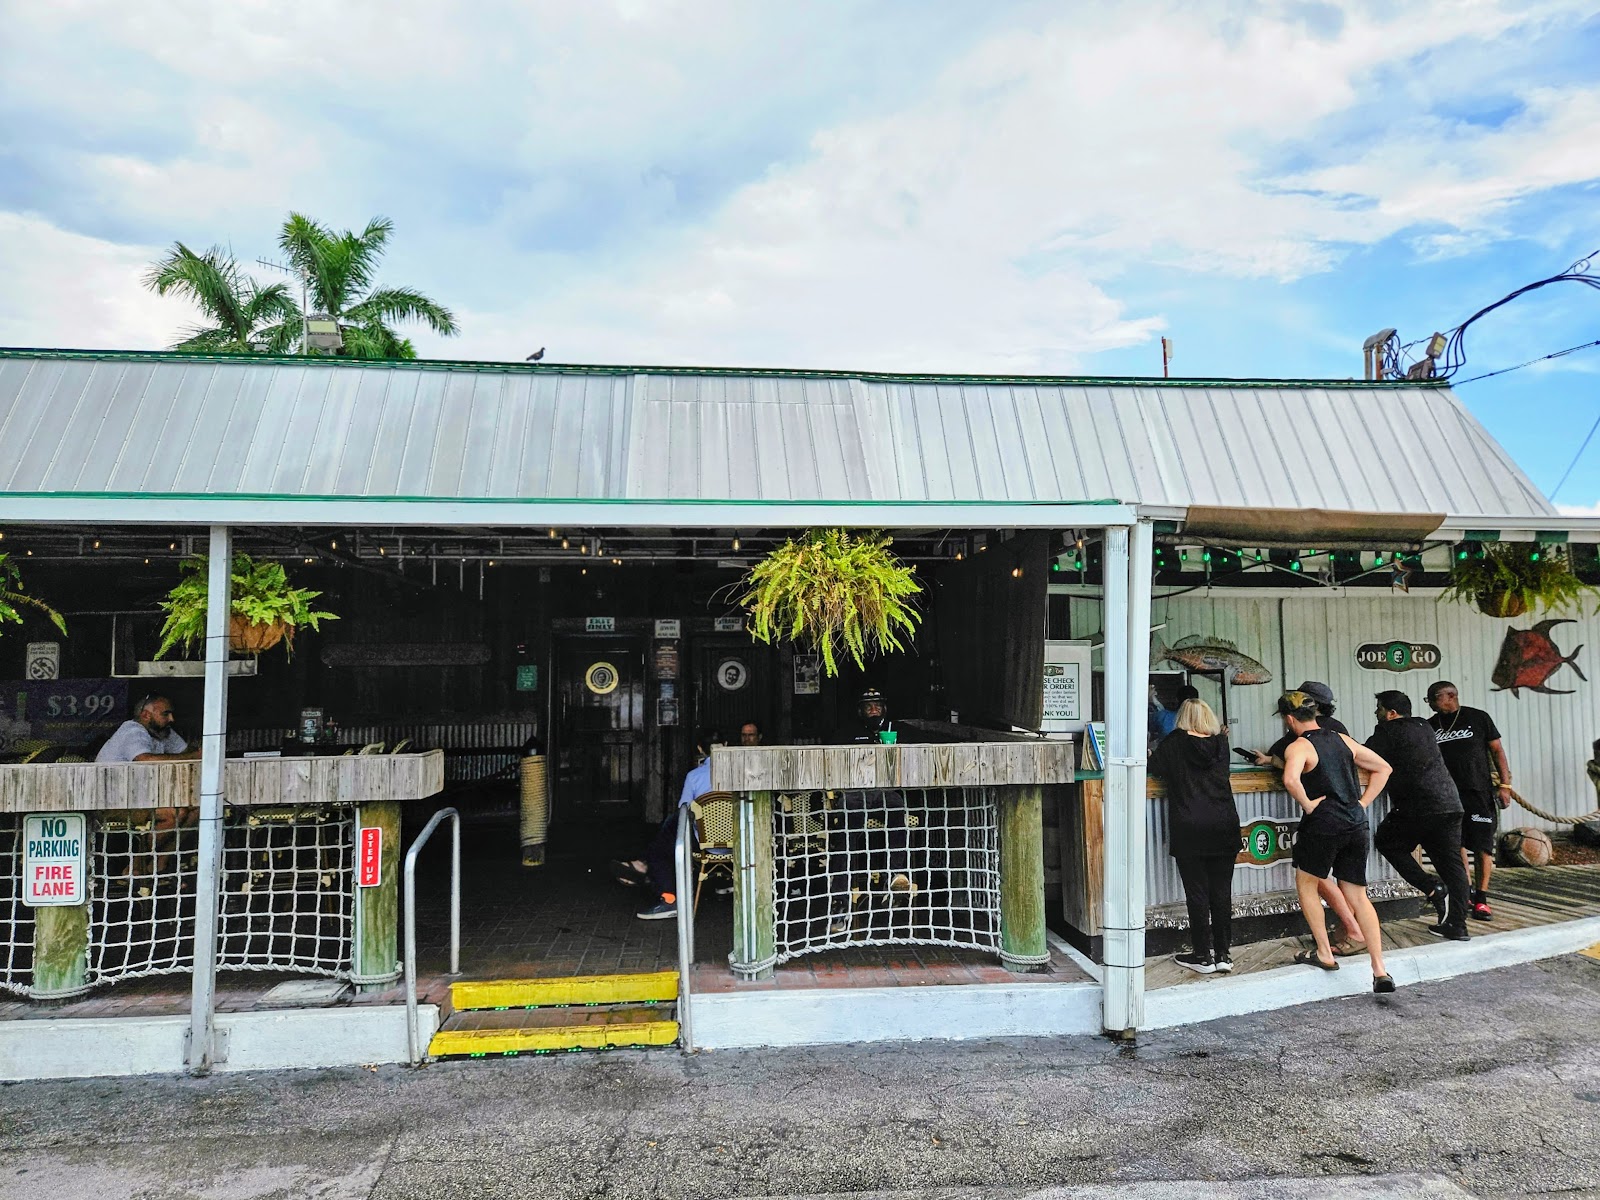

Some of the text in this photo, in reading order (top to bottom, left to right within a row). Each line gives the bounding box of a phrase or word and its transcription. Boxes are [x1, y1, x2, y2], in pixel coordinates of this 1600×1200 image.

[1358, 651, 1387, 662] JOE
[1412, 650, 1436, 663] GO
[47, 694, 115, 717] $3.99
[41, 818, 67, 837] NO
[29, 839, 79, 857] PARKING
[35, 866, 72, 880] FIRE
[366, 866, 374, 881] UP
[33, 882, 74, 896] LANE
